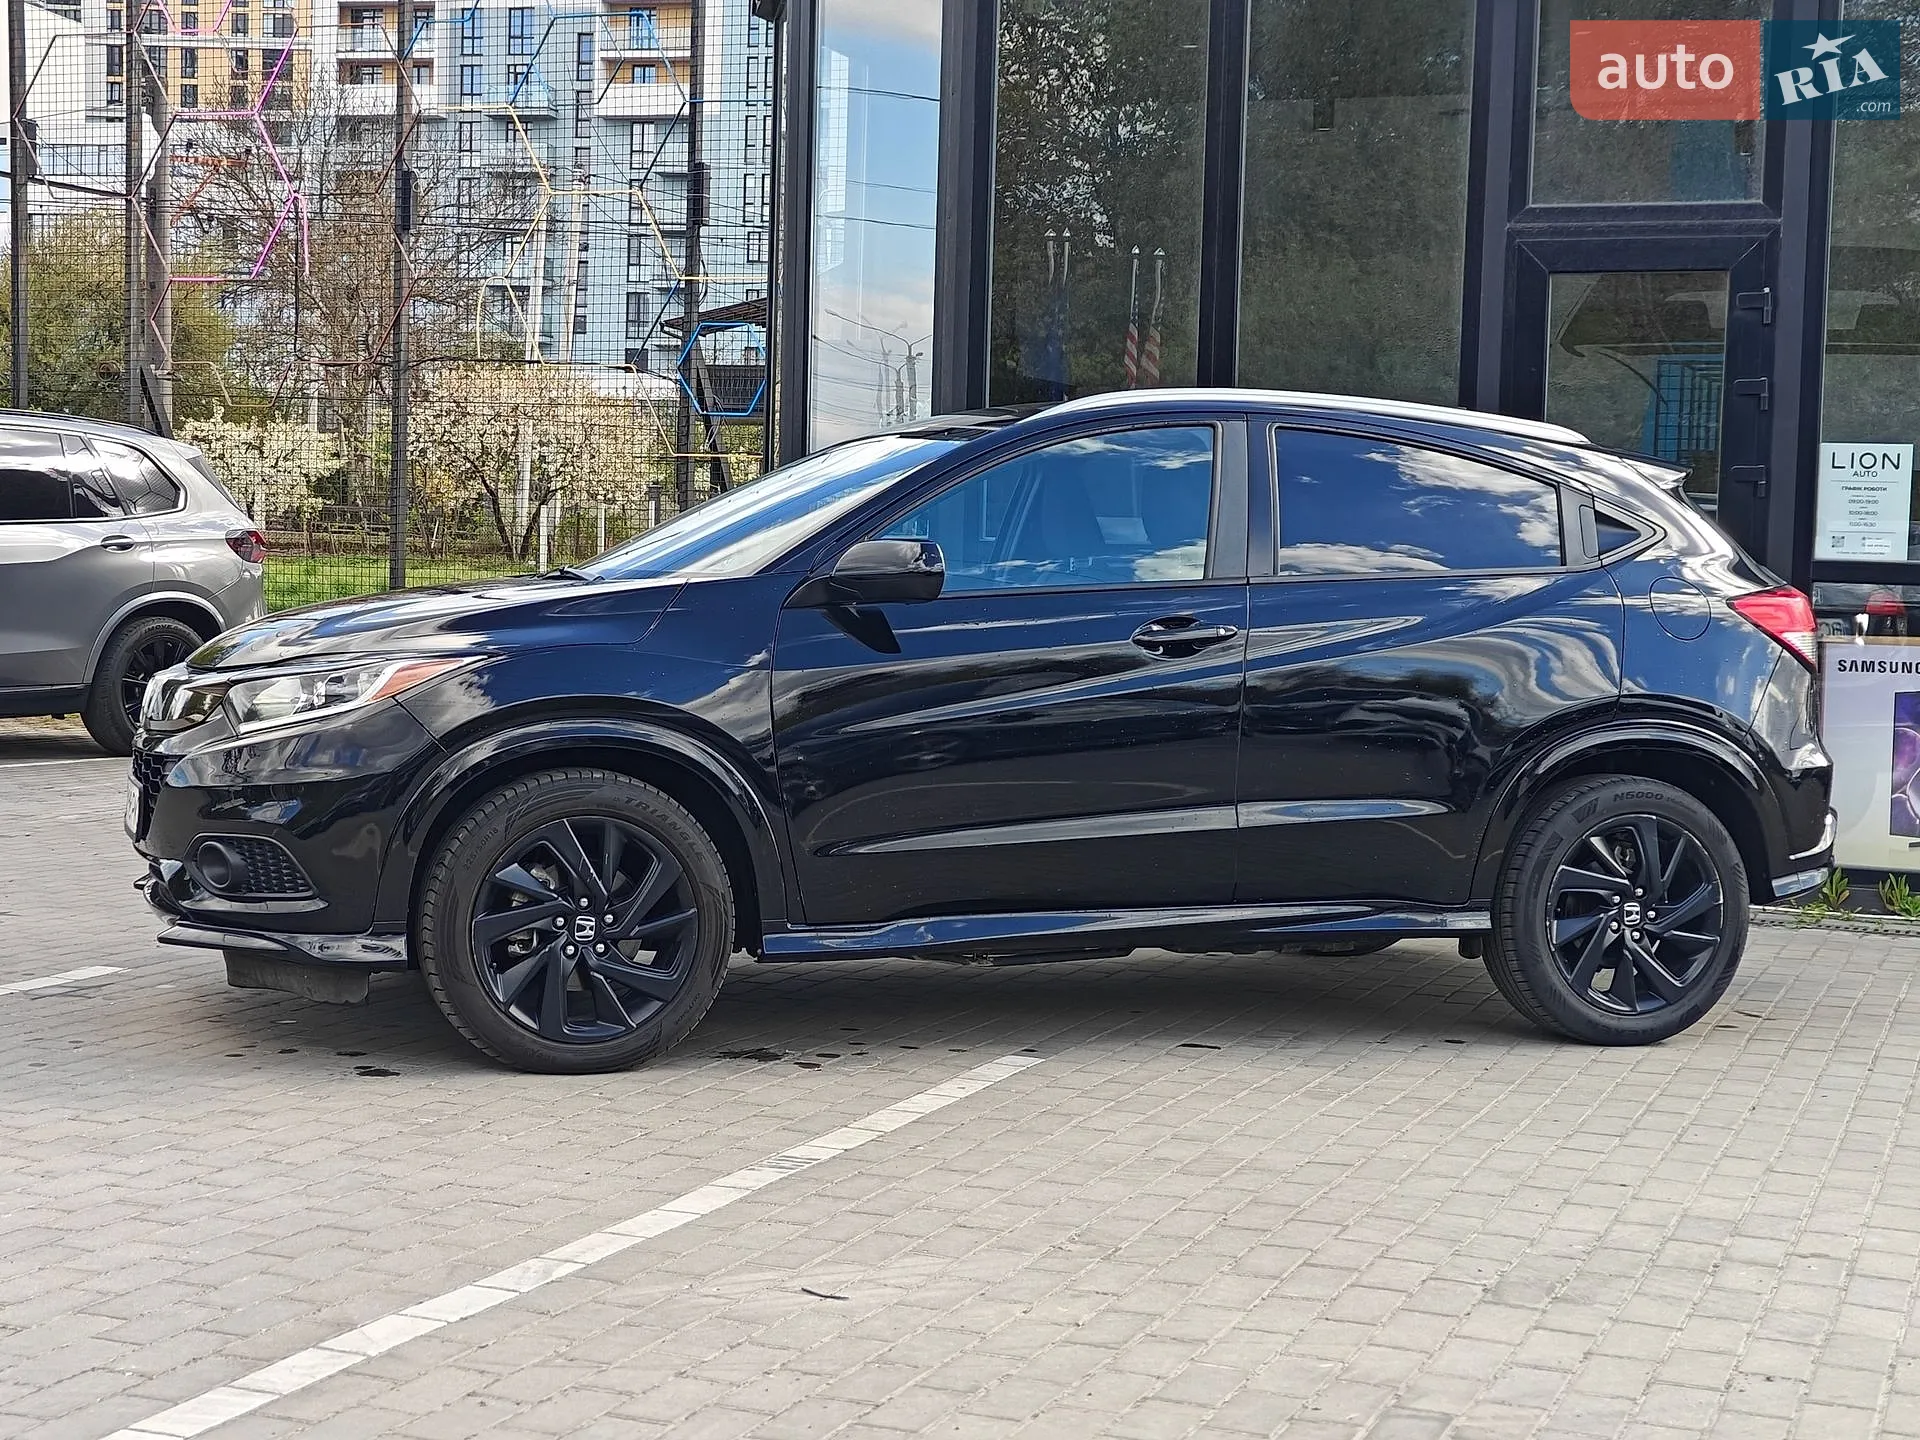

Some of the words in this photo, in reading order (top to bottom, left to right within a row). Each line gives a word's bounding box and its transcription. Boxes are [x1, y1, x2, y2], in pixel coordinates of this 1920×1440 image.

[1832, 452, 1901, 470] LION
[1852, 470, 1878, 478] AUTO
[1613, 791, 1664, 802] N5000
